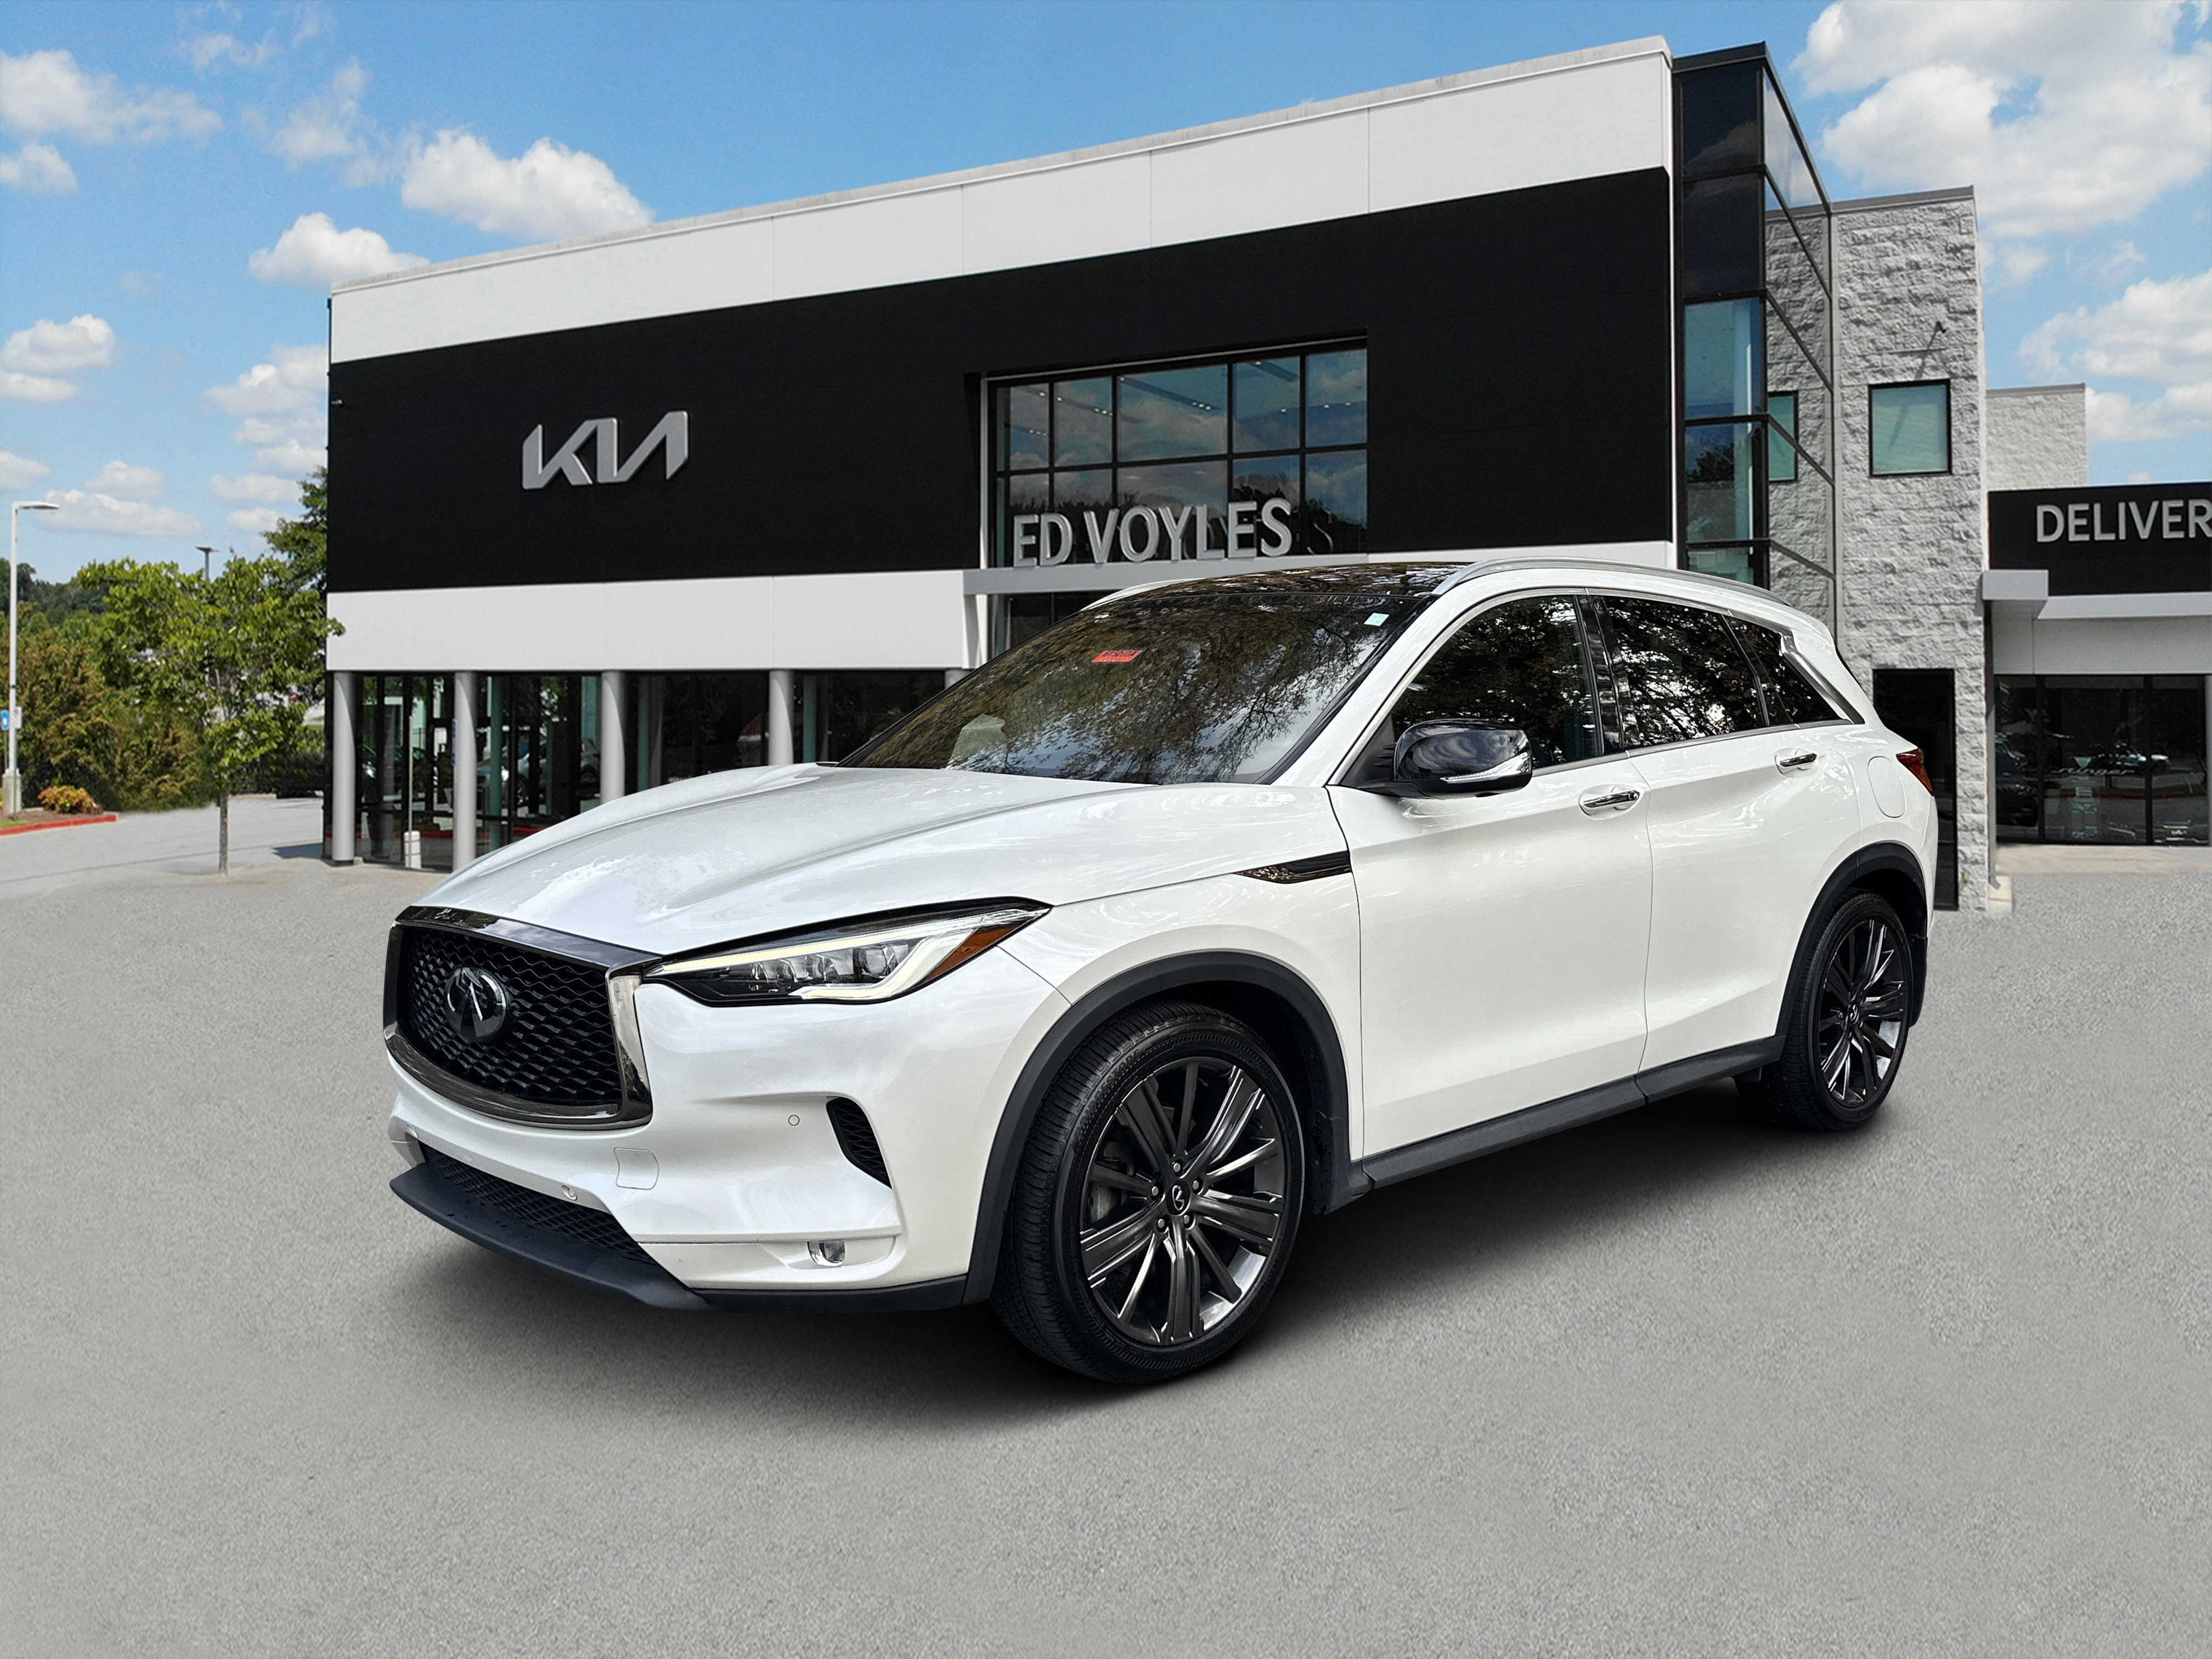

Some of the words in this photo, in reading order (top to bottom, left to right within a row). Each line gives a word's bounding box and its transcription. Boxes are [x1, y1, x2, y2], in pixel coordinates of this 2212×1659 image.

[522, 411, 688, 489] KIA
[1013, 514, 1073, 568] ED
[1084, 497, 1293, 565] VOYLES
[2036, 499, 2212, 543] DELIVER
